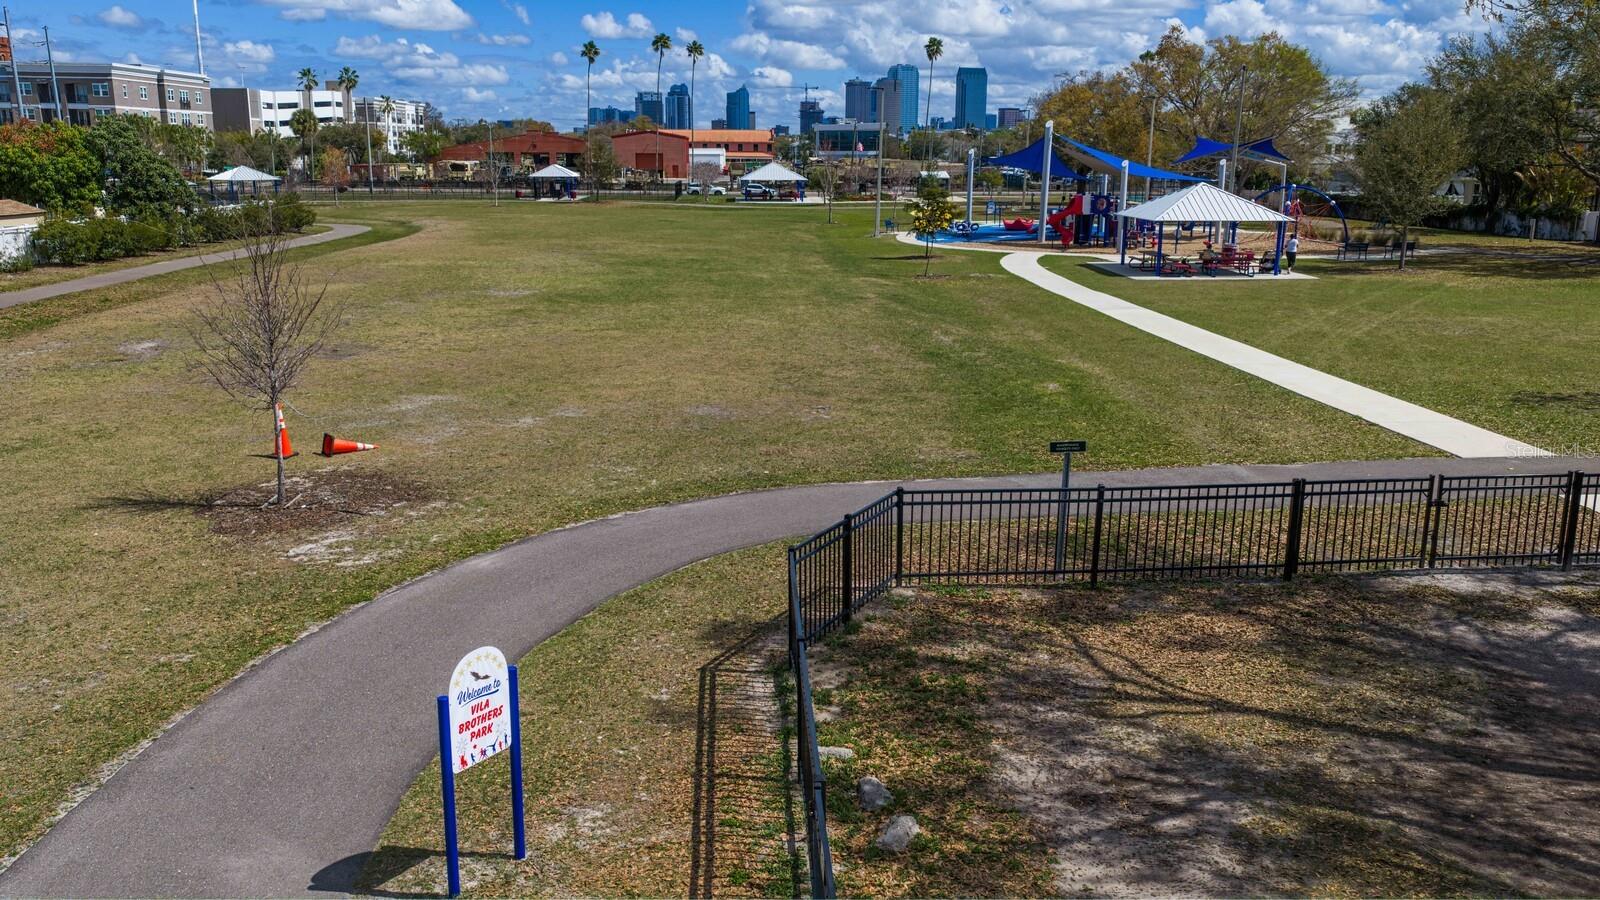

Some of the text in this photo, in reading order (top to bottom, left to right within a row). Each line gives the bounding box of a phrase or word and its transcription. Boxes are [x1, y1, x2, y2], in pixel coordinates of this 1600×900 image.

[457, 678, 501, 705] Welcome to
[470, 699, 490, 716] VILA
[458, 705, 504, 735] BROTHERS
[470, 722, 494, 742] PARK
